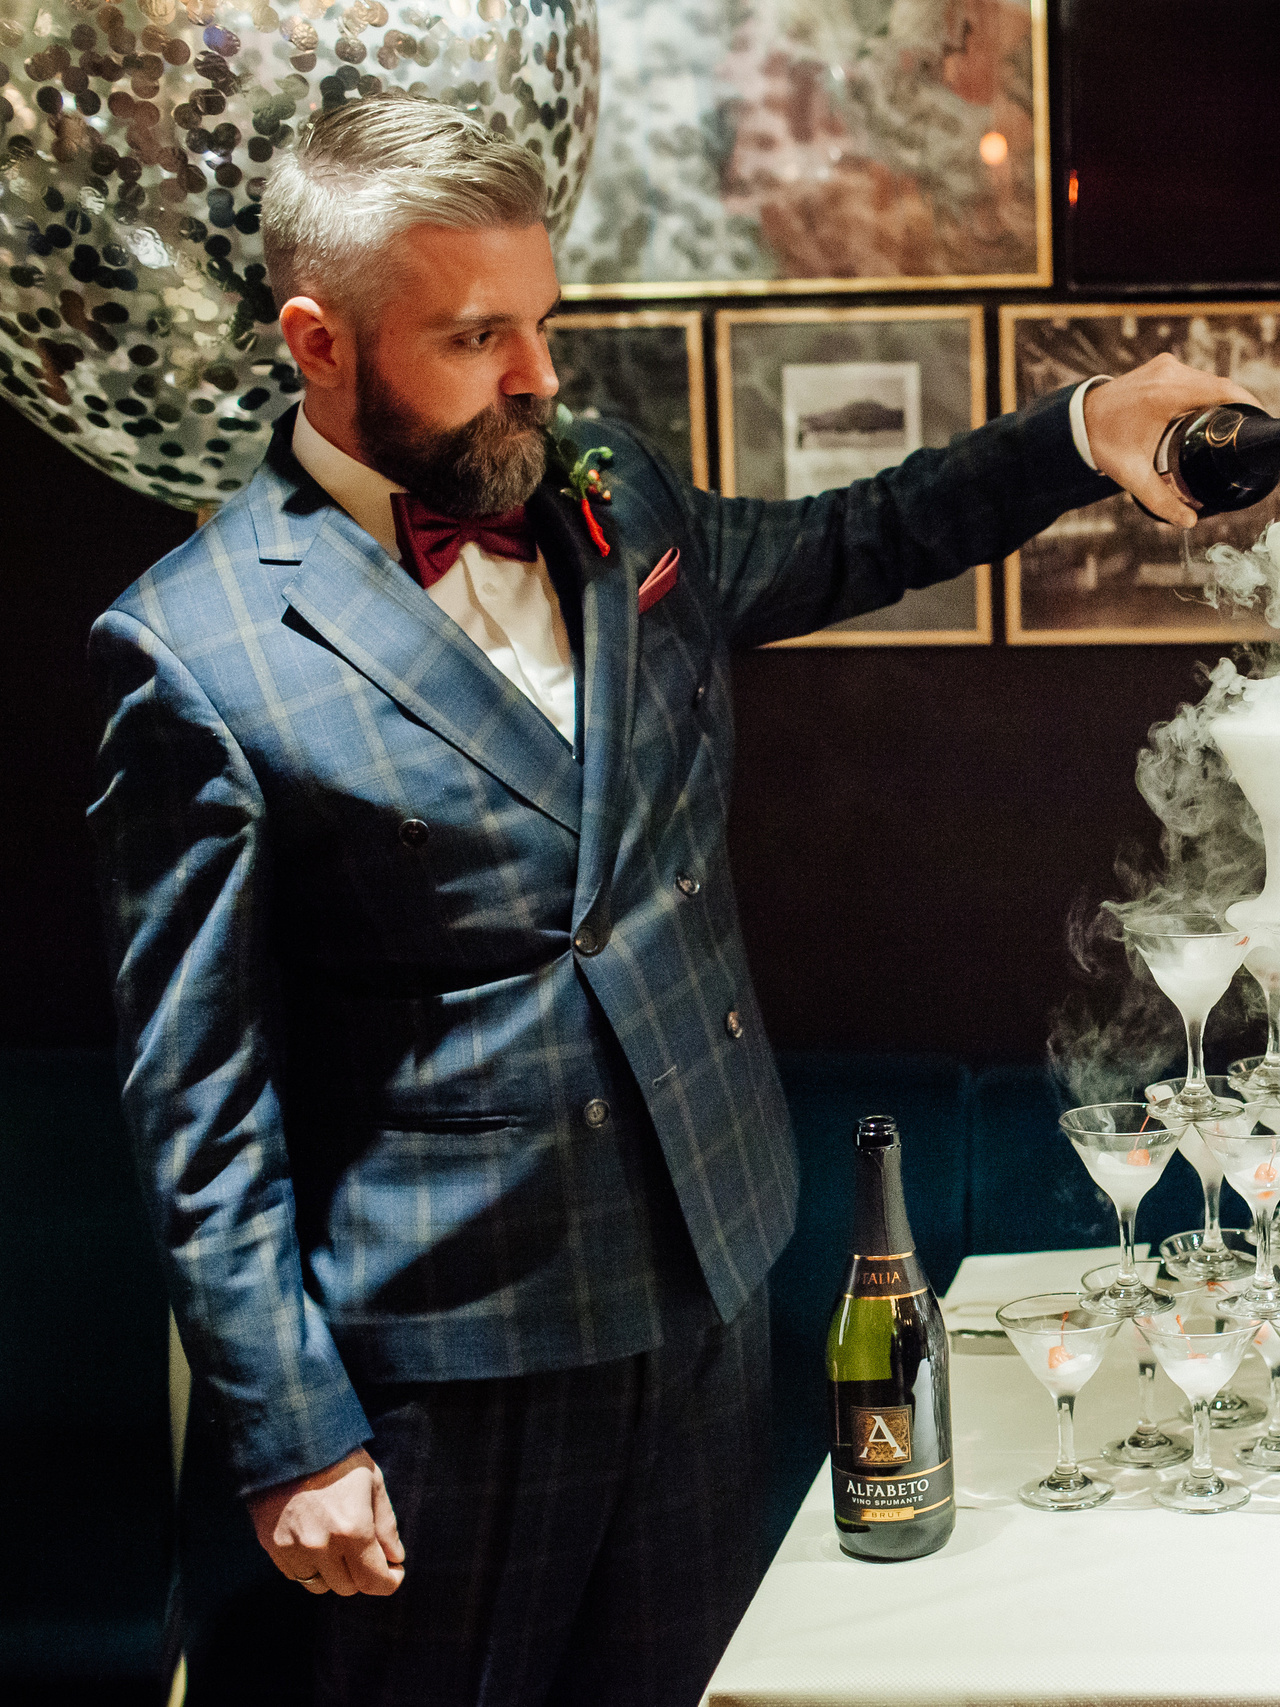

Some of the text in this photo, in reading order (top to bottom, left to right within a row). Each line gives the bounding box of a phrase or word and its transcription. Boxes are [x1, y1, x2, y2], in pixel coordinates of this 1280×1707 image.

[859, 1415, 907, 1458] A
[846, 1478, 930, 1498] ALFABETO
[851, 1494, 925, 1507] VINO SPUMANTE
[871, 1511, 902, 1519] BRUT
